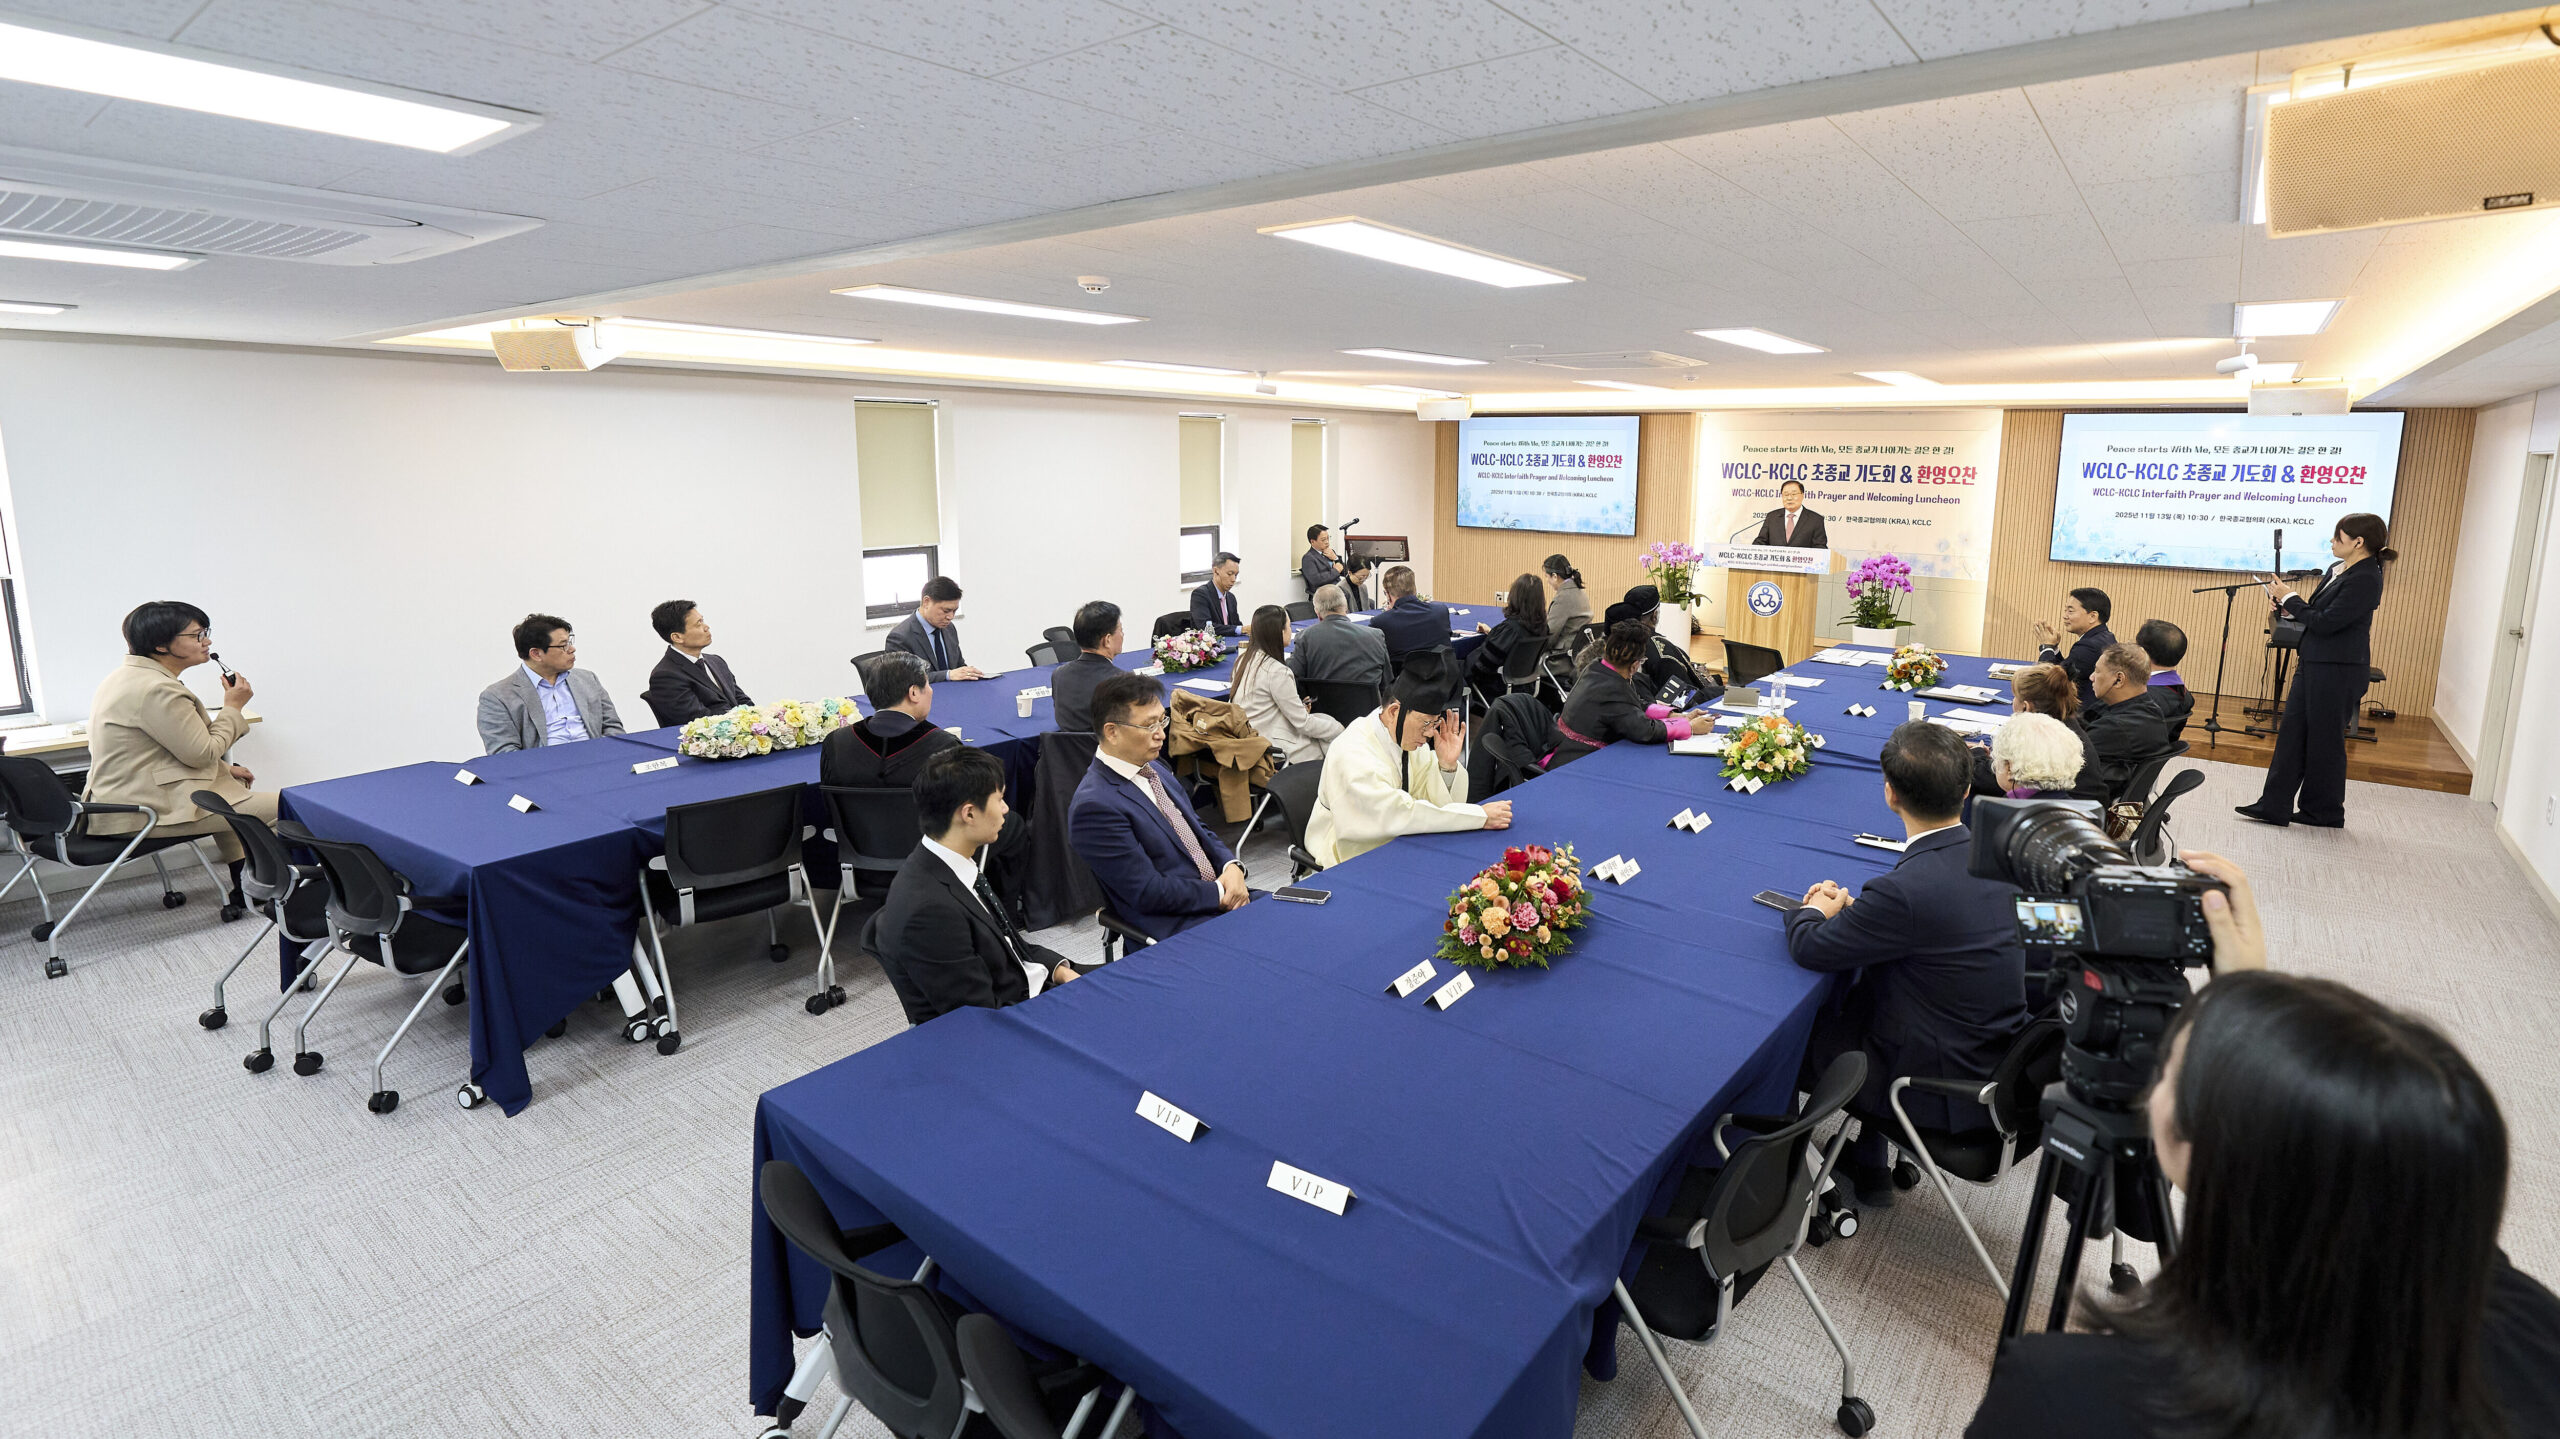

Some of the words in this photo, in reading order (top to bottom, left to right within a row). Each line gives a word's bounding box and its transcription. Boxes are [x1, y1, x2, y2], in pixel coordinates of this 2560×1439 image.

[1743, 445, 1769, 453] Peace
[1770, 445, 1798, 453] starts
[1799, 445, 1819, 453] With
[1821, 445, 1836, 455] Me,
[1838, 445, 1853, 454] 모든
[1855, 445, 1879, 454] 종교가
[1880, 446, 1912, 455] 나아가는
[1932, 446, 1941, 455] 한
[2107, 445, 2136, 453] Peace
[2137, 445, 2169, 453] starts
[2171, 445, 2193, 454] With
[2194, 445, 2211, 455] Me,
[2213, 446, 2231, 454] 모든
[2232, 446, 2258, 454] 종교가
[2260, 446, 2295, 455] 나아가는
[2317, 446, 2327, 455] 한
[1471, 453, 1523, 466] WCLC-KCLC
[1525, 453, 1549, 467] 초종교
[1551, 454, 1575, 467] 기도회
[1578, 454, 1585, 467] &
[1588, 454, 1623, 468] 환영오찬
[1722, 462, 1808, 481] WCLC-KCLC
[1811, 463, 1851, 482] 초종교
[1854, 464, 1896, 483] 기도회
[1900, 465, 1913, 484] &
[1917, 465, 1978, 485] 환영오찬
[2082, 462, 2179, 481] WCLC-KCLC
[2182, 463, 2227, 482] 초종교
[2230, 464, 2277, 483] 기도회
[2281, 465, 2295, 483] &
[2300, 464, 2367, 485] 환영오찬
[1732, 488, 1774, 498] WCLC-KCLC
[1817, 490, 1847, 502] Prayer
[1848, 492, 1865, 501] and
[1866, 492, 1914, 505] Welcoming
[1915, 494, 1961, 505] Luncheon
[2092, 487, 2140, 498] WCLC-KCLC
[2141, 489, 2187, 499] Interfaith
[2188, 490, 2221, 502] Prayer
[2223, 492, 2241, 501] and
[2243, 492, 2295, 504] Welcoming
[2297, 493, 2347, 504] Luncheon
[1846, 515, 1887, 524] 한국종교협의회
[1912, 518, 1932, 526] KCLC
[2115, 511, 2139, 519] 2025년
[2140, 512, 2155, 520] 11월
[2219, 515, 2265, 524] 한국종교협의회
[1445, 981, 1464, 999] VIP
[1156, 1104, 1181, 1127] VIP
[1291, 1175, 1324, 1200] VIP
